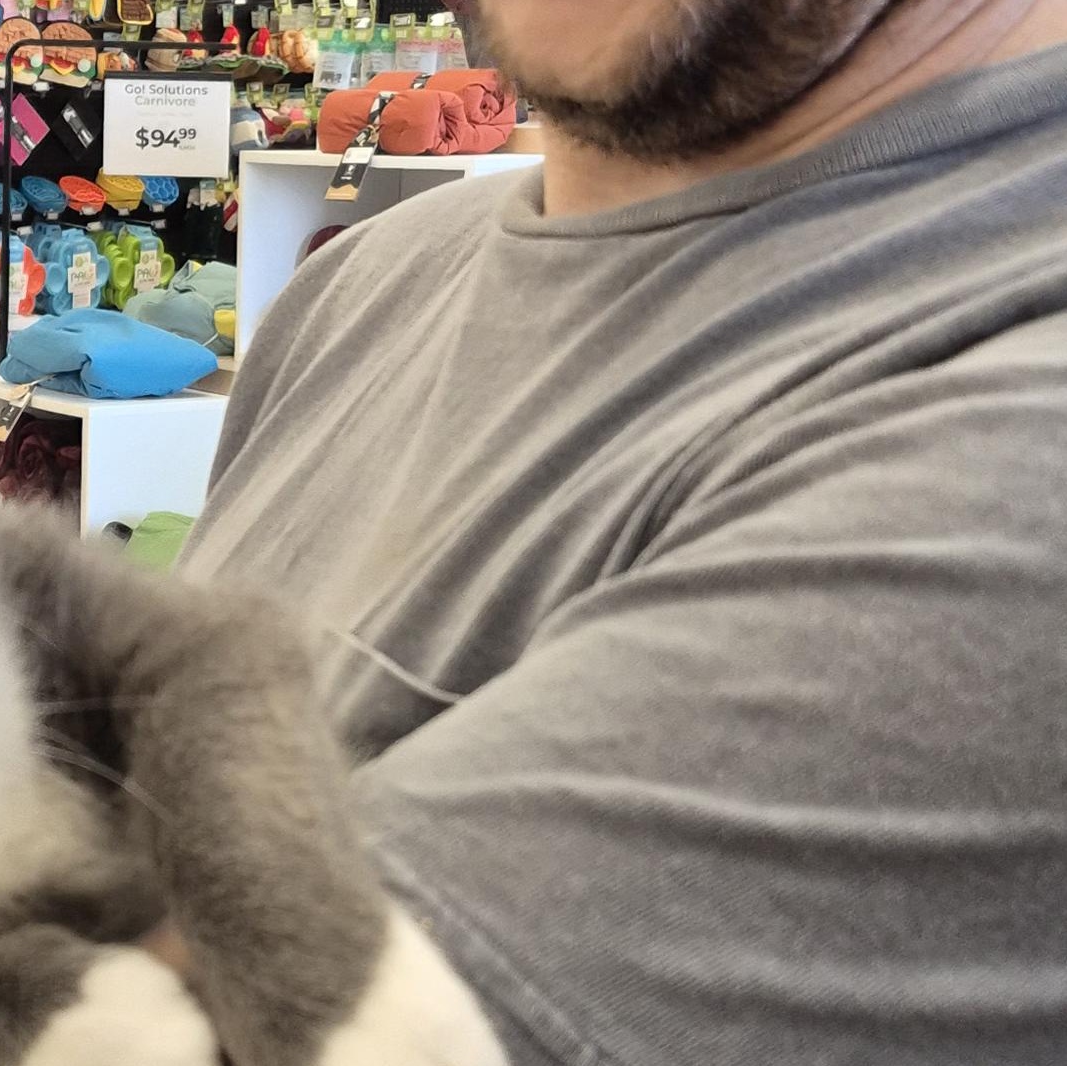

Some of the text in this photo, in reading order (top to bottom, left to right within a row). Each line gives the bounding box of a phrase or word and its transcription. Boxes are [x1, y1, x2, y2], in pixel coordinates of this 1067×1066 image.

[125, 84, 208, 95] Go! Solutions
[135, 95, 196, 106] Carnivore
